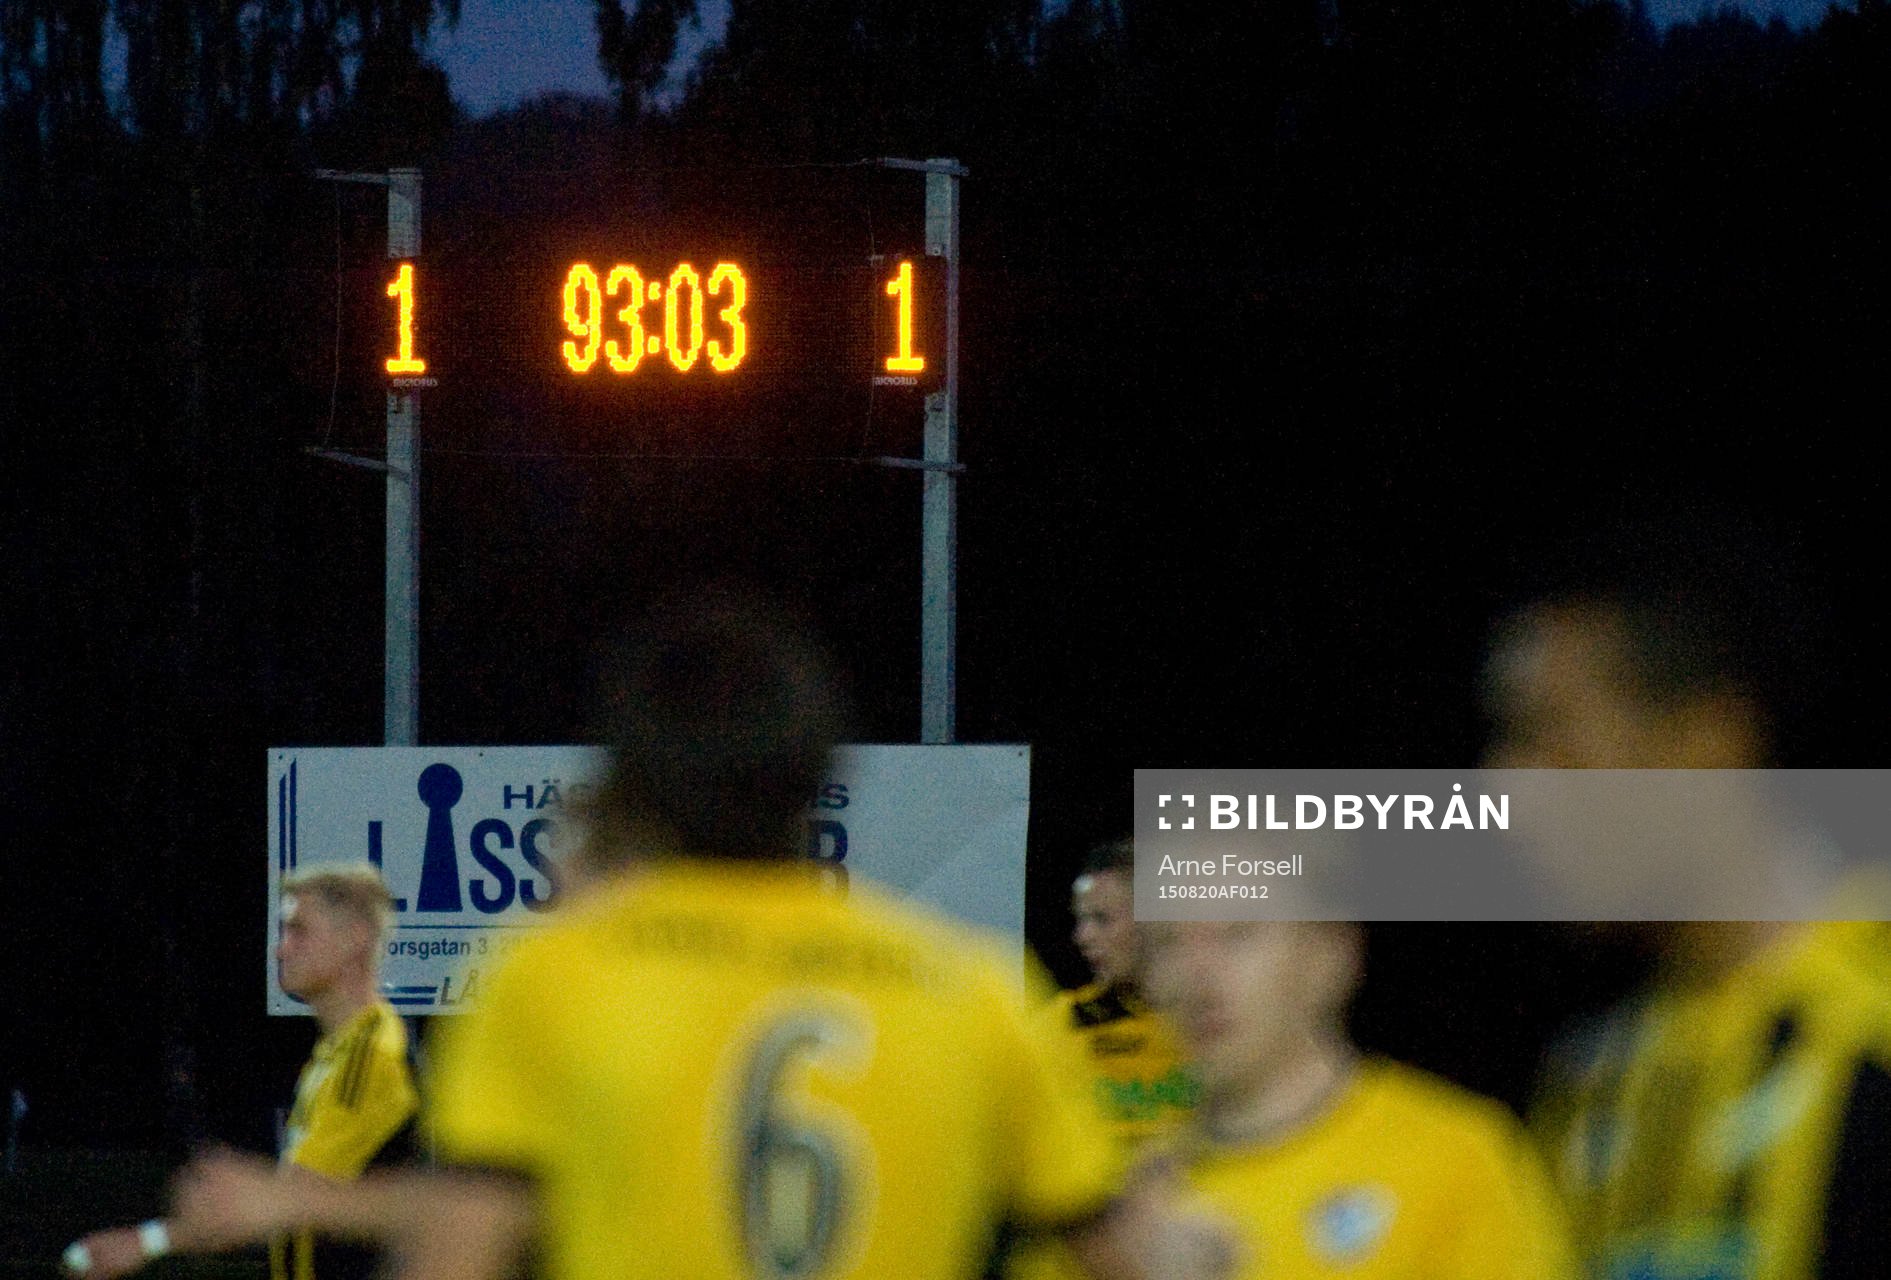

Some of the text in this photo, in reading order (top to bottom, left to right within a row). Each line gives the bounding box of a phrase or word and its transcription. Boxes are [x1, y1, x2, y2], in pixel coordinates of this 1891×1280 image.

[386, 263, 925, 373] 1 93:03 1
[718, 988, 875, 1280] 6
